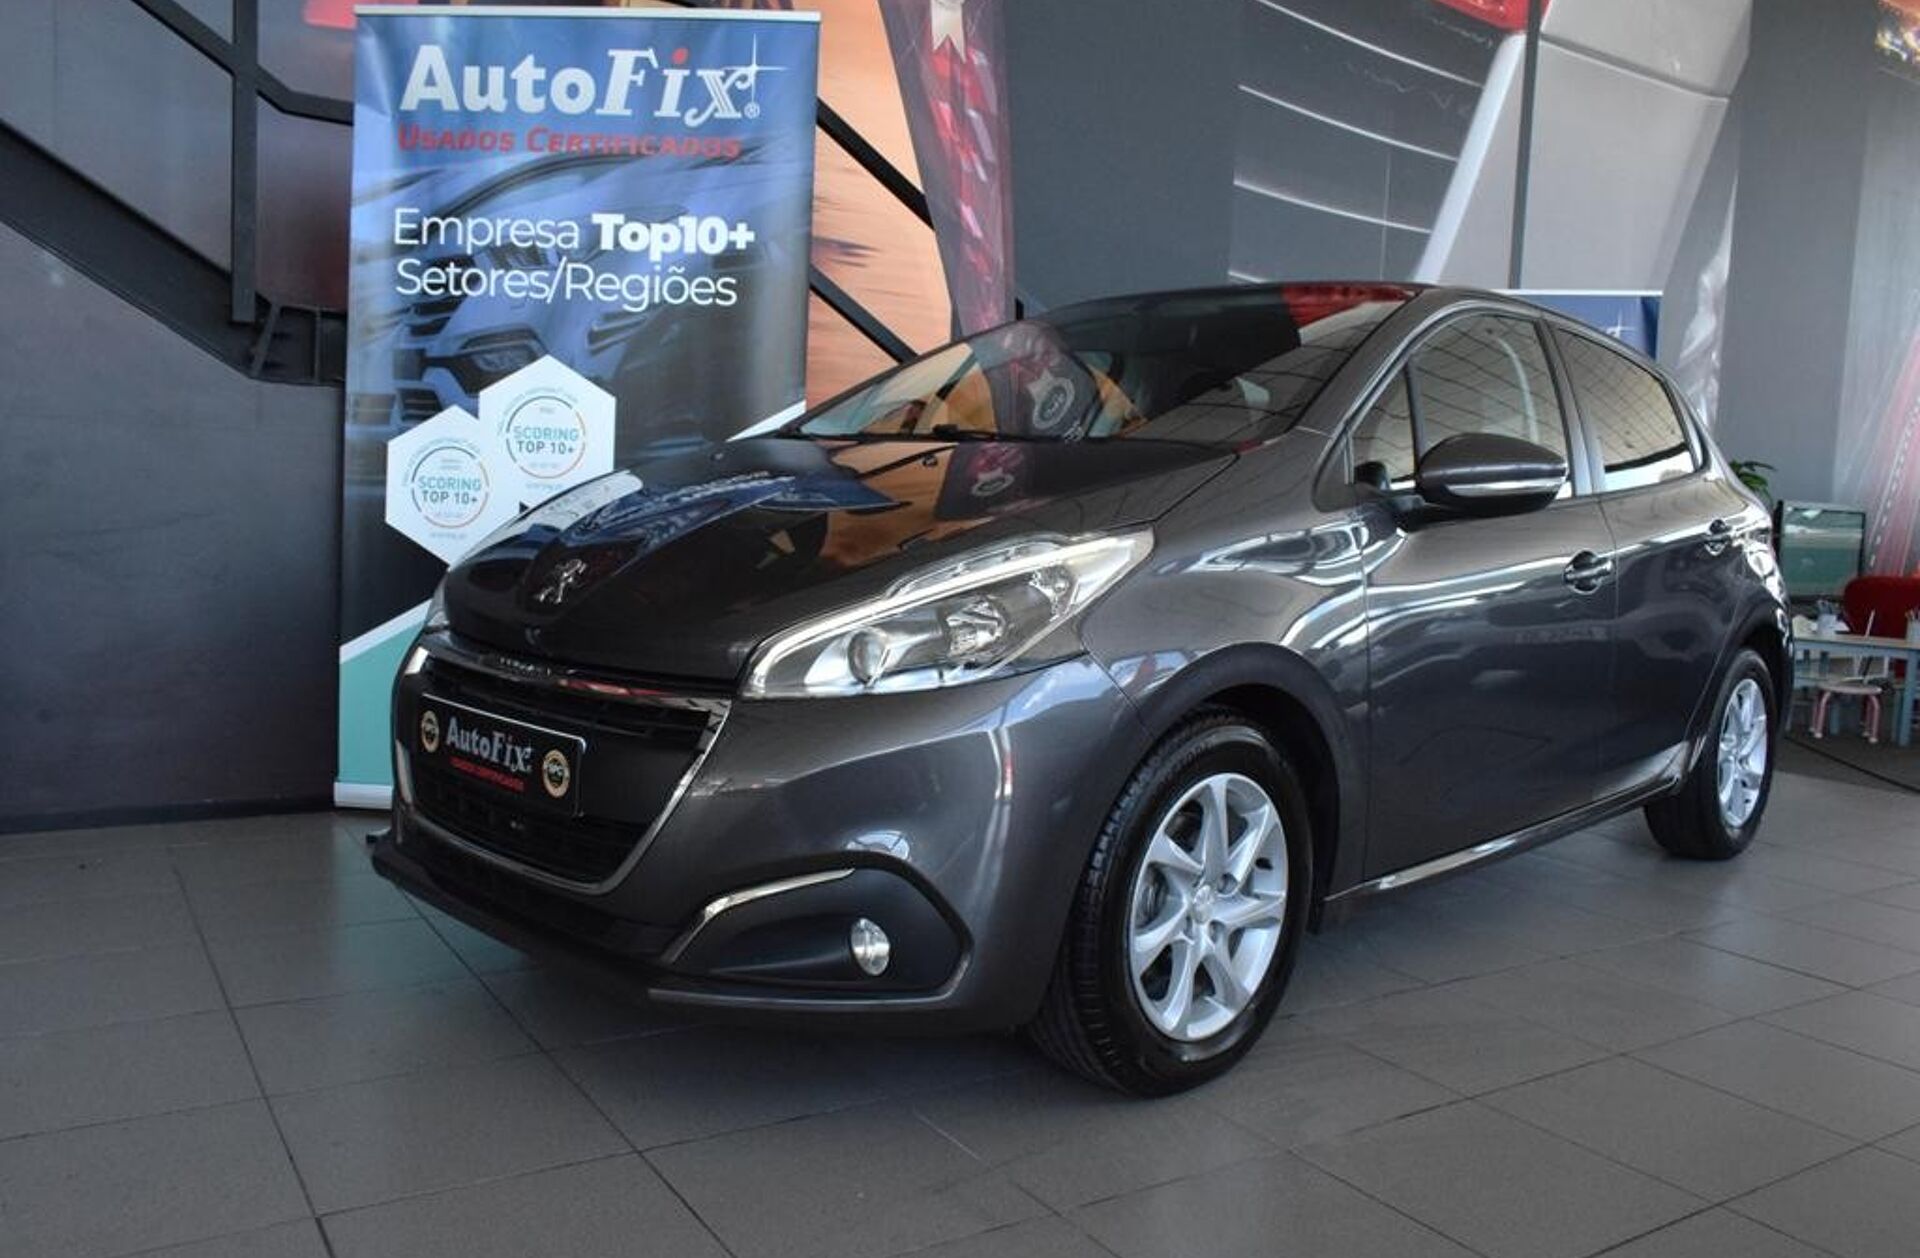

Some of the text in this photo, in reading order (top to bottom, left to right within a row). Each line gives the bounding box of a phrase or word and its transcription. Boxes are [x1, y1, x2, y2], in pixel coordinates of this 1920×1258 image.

[394, 208, 755, 261] Empresa Top10+
[396, 257, 738, 312] Setores/Regiões
[513, 424, 579, 442] SCORING
[516, 440, 574, 455] TOP 10+
[418, 475, 481, 490] SCORING
[422, 490, 478, 505] TOP 10+
